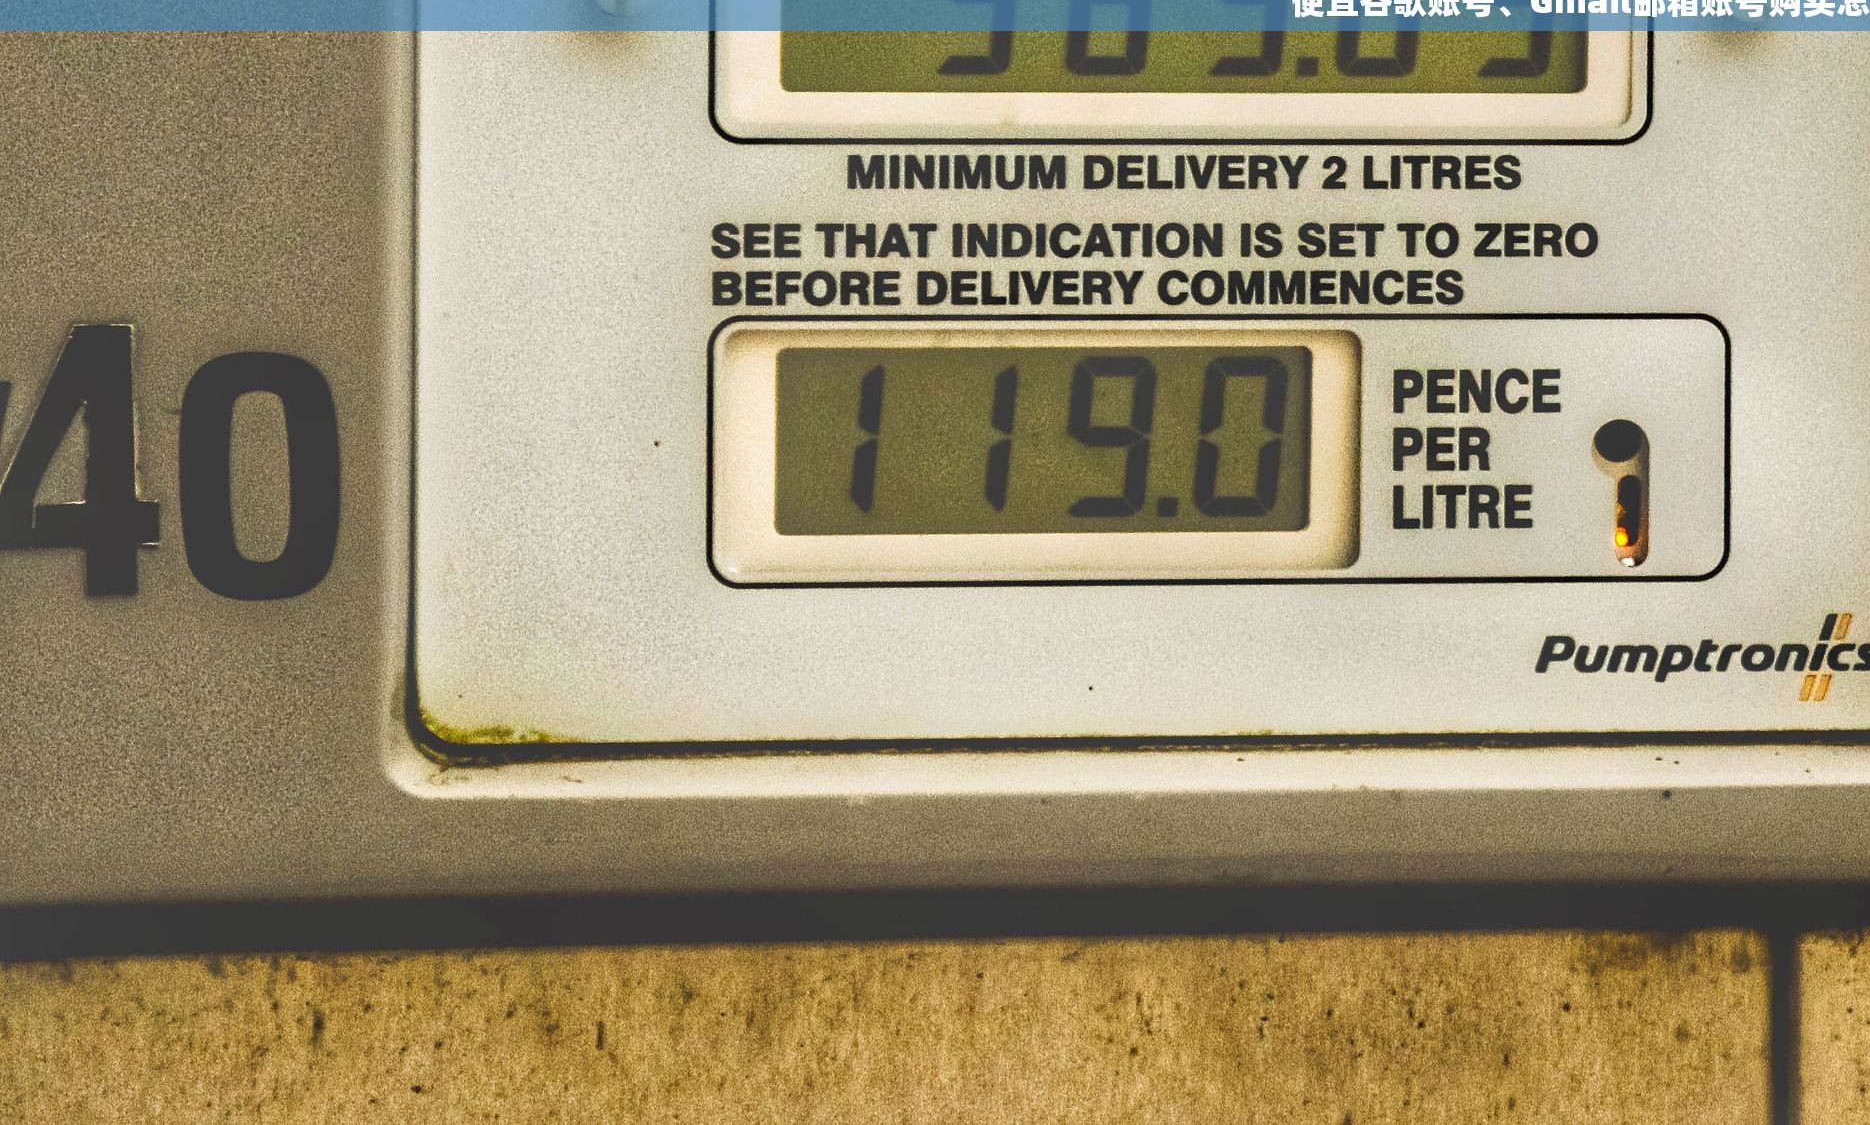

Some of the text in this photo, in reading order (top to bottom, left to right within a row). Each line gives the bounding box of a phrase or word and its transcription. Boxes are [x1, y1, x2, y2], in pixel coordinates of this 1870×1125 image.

[847, 155, 1522, 191] MINIMUM DELIVERY 2 LITRES
[711, 222, 1599, 260] SEE THAT INDICATION IS SET TO ZERO
[711, 269, 1465, 307] BEFORE DELIVERY COMMENCES
[1392, 368, 1562, 415] PENCE
[849, 355, 1290, 519] 119.0
[1392, 426, 1491, 472] PER
[1392, 483, 1534, 530] LITRE
